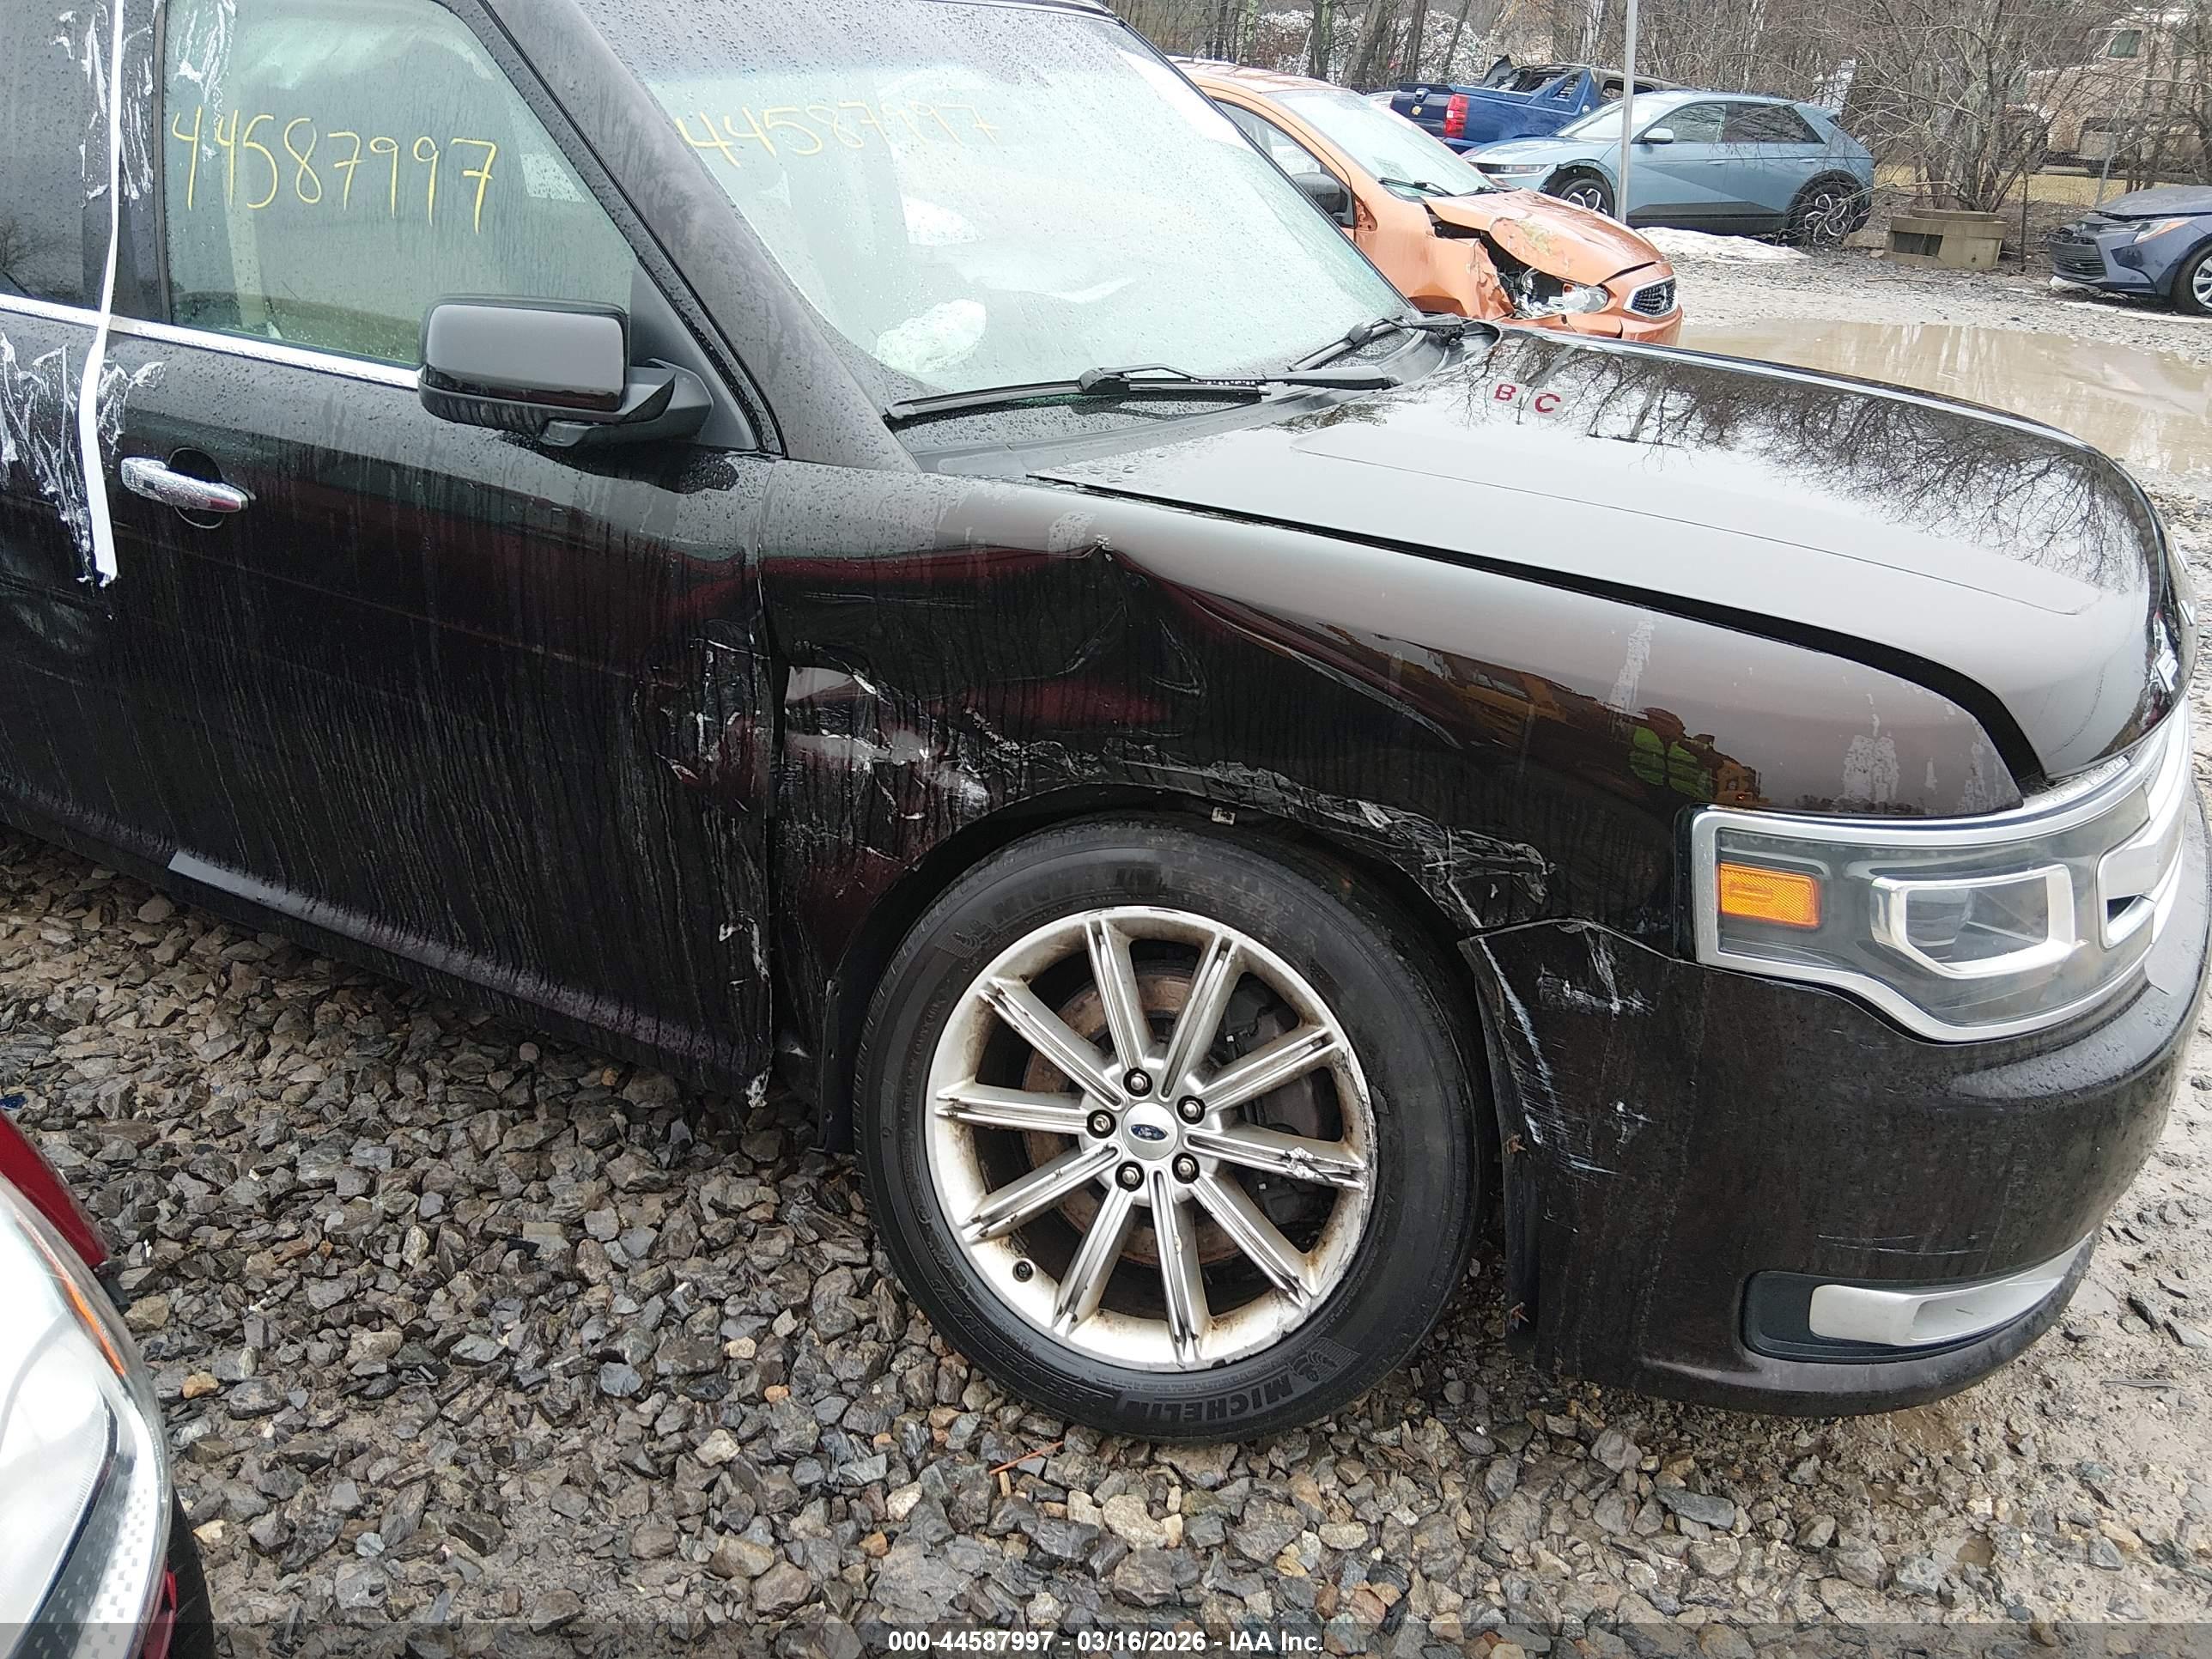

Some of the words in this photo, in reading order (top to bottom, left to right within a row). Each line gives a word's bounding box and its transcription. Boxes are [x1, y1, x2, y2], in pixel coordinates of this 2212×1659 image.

[674, 100, 1000, 167] 44587997
[172, 105, 497, 234] 44587997
[1494, 383, 1516, 401] B
[1534, 392, 1561, 413] C
[1123, 1374, 1293, 1421] MICHELIN
